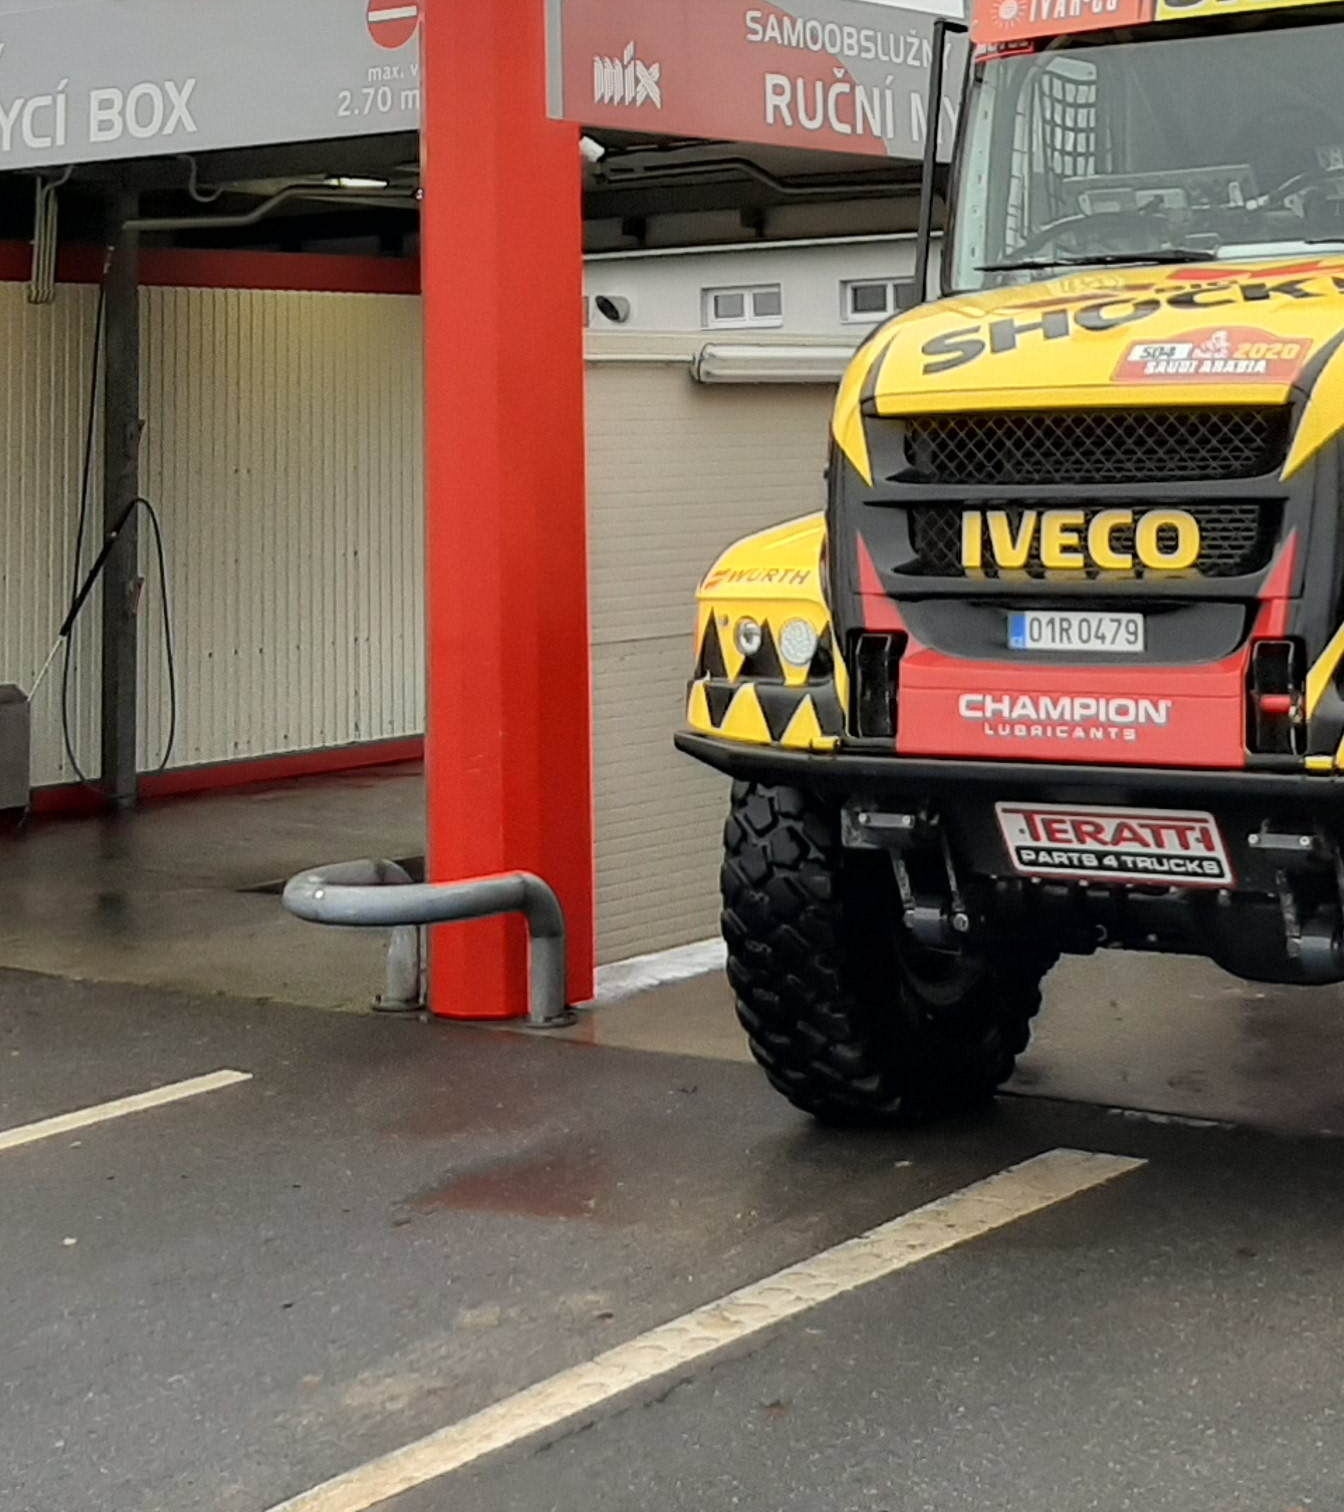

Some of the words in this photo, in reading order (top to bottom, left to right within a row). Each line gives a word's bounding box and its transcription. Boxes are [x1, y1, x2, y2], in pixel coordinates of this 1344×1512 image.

[88, 78, 198, 143] BOX
[337, 86, 392, 117] 2.70
[764, 66, 895, 139] RUČNÍ
[1233, 342, 1301, 360] 2020
[1144, 359, 1198, 375] SAUDI
[1199, 359, 1267, 374] ARABIA
[960, 508, 1203, 570] IVECO
[958, 693, 1170, 725] CHAMPION
[983, 721, 1138, 742] LUBRICANTS
[1019, 848, 1099, 868] PARTS
[1102, 853, 1120, 869] 4
[1120, 854, 1222, 876] TRUCKS
